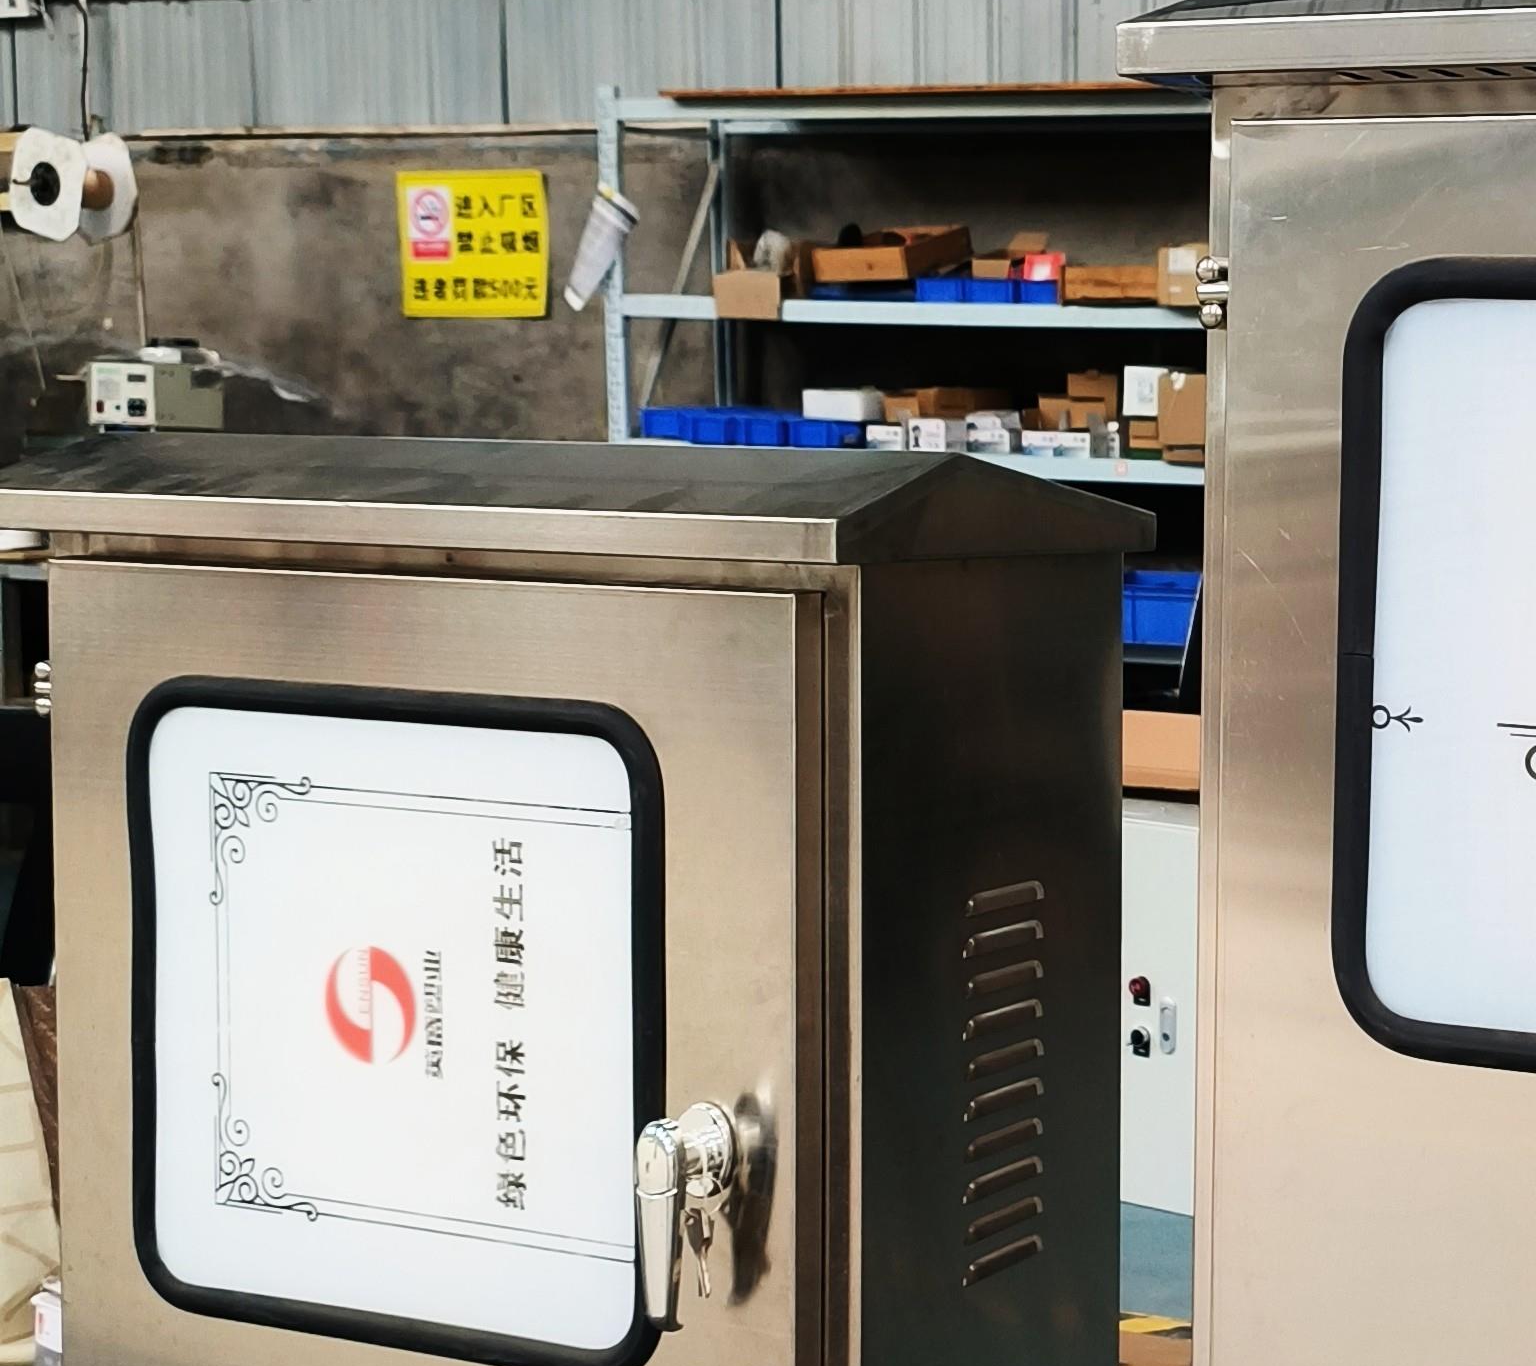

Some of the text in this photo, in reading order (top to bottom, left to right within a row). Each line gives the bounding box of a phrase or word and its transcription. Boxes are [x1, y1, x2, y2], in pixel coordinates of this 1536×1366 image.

[455, 193, 539, 219] 进入厂区
[456, 229, 540, 255] 禁止吸烟
[413, 276, 539, 302] 违者罚款500元
[492, 836, 527, 1211] 绿色环保 健康生活
